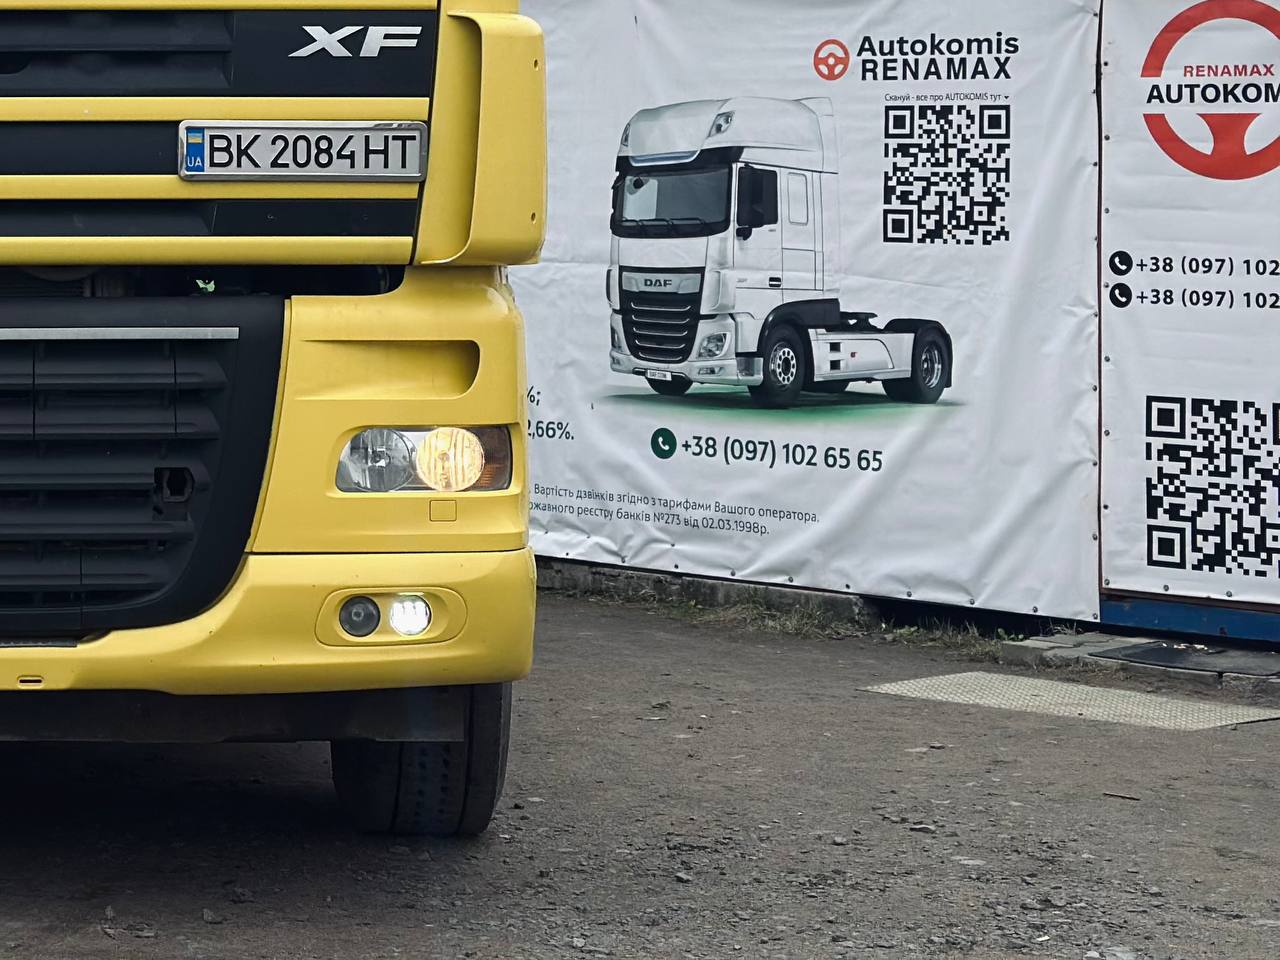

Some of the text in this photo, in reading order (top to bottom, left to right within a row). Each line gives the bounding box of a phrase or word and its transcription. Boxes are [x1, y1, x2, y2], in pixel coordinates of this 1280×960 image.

[287, 26, 422, 57] XF
[856, 31, 1020, 57] Autokomis
[861, 56, 1012, 81] RENAMAX
[1183, 63, 1275, 77] RENAMAX
[884, 93, 911, 103] Скануй
[929, 94, 944, 103] про
[945, 92, 988, 101] AUTOKOMIS
[990, 94, 1001, 102] тут
[1146, 83, 1280, 103] AUTOKOM
[187, 155, 202, 167] UA
[208, 134, 417, 169] BK 2084 HT
[1136, 256, 1280, 276] +38 (097) 102
[643, 278, 672, 287] DAF
[1136, 288, 1280, 309] +38 (097) 102
[682, 435, 883, 472] +38 (097) 102 65 65
[534, 483, 820, 524] Вартість дзвінків згідно з тарифами Вашого оператора.
[577, 506, 613, 521] реєстру
[616, 507, 651, 522] банків
[683, 516, 699, 529] від
